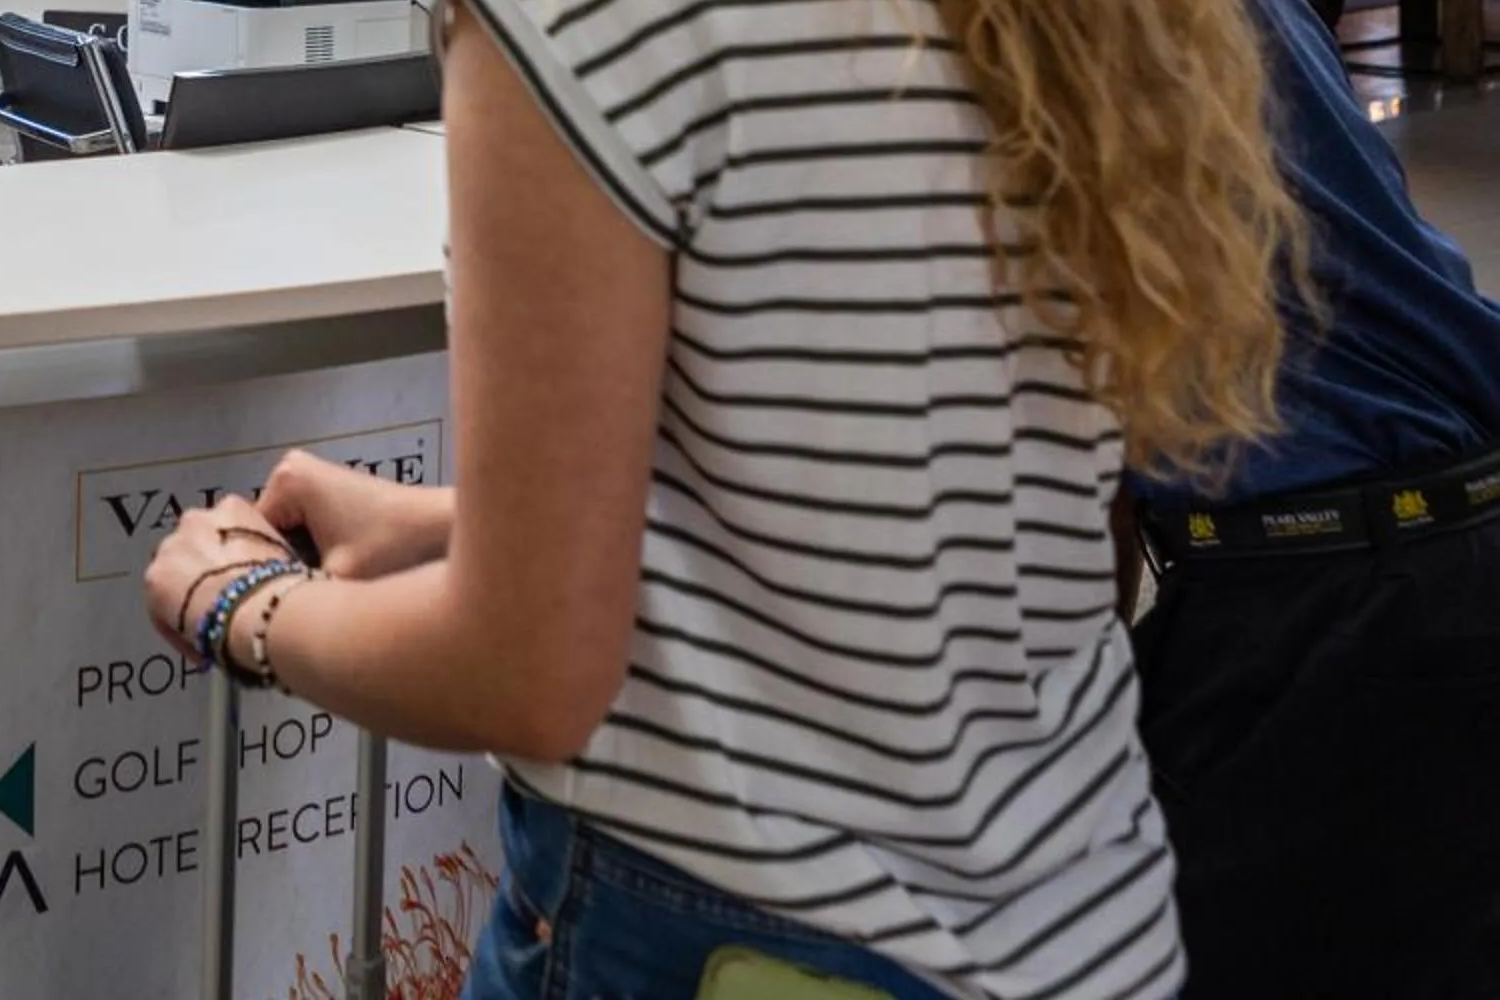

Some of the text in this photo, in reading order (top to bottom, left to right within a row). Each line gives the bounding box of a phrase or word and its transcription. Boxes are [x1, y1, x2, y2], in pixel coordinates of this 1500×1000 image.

[74, 712, 333, 800] GOLF HOP
[74, 764, 464, 894] HOTE RECEION
